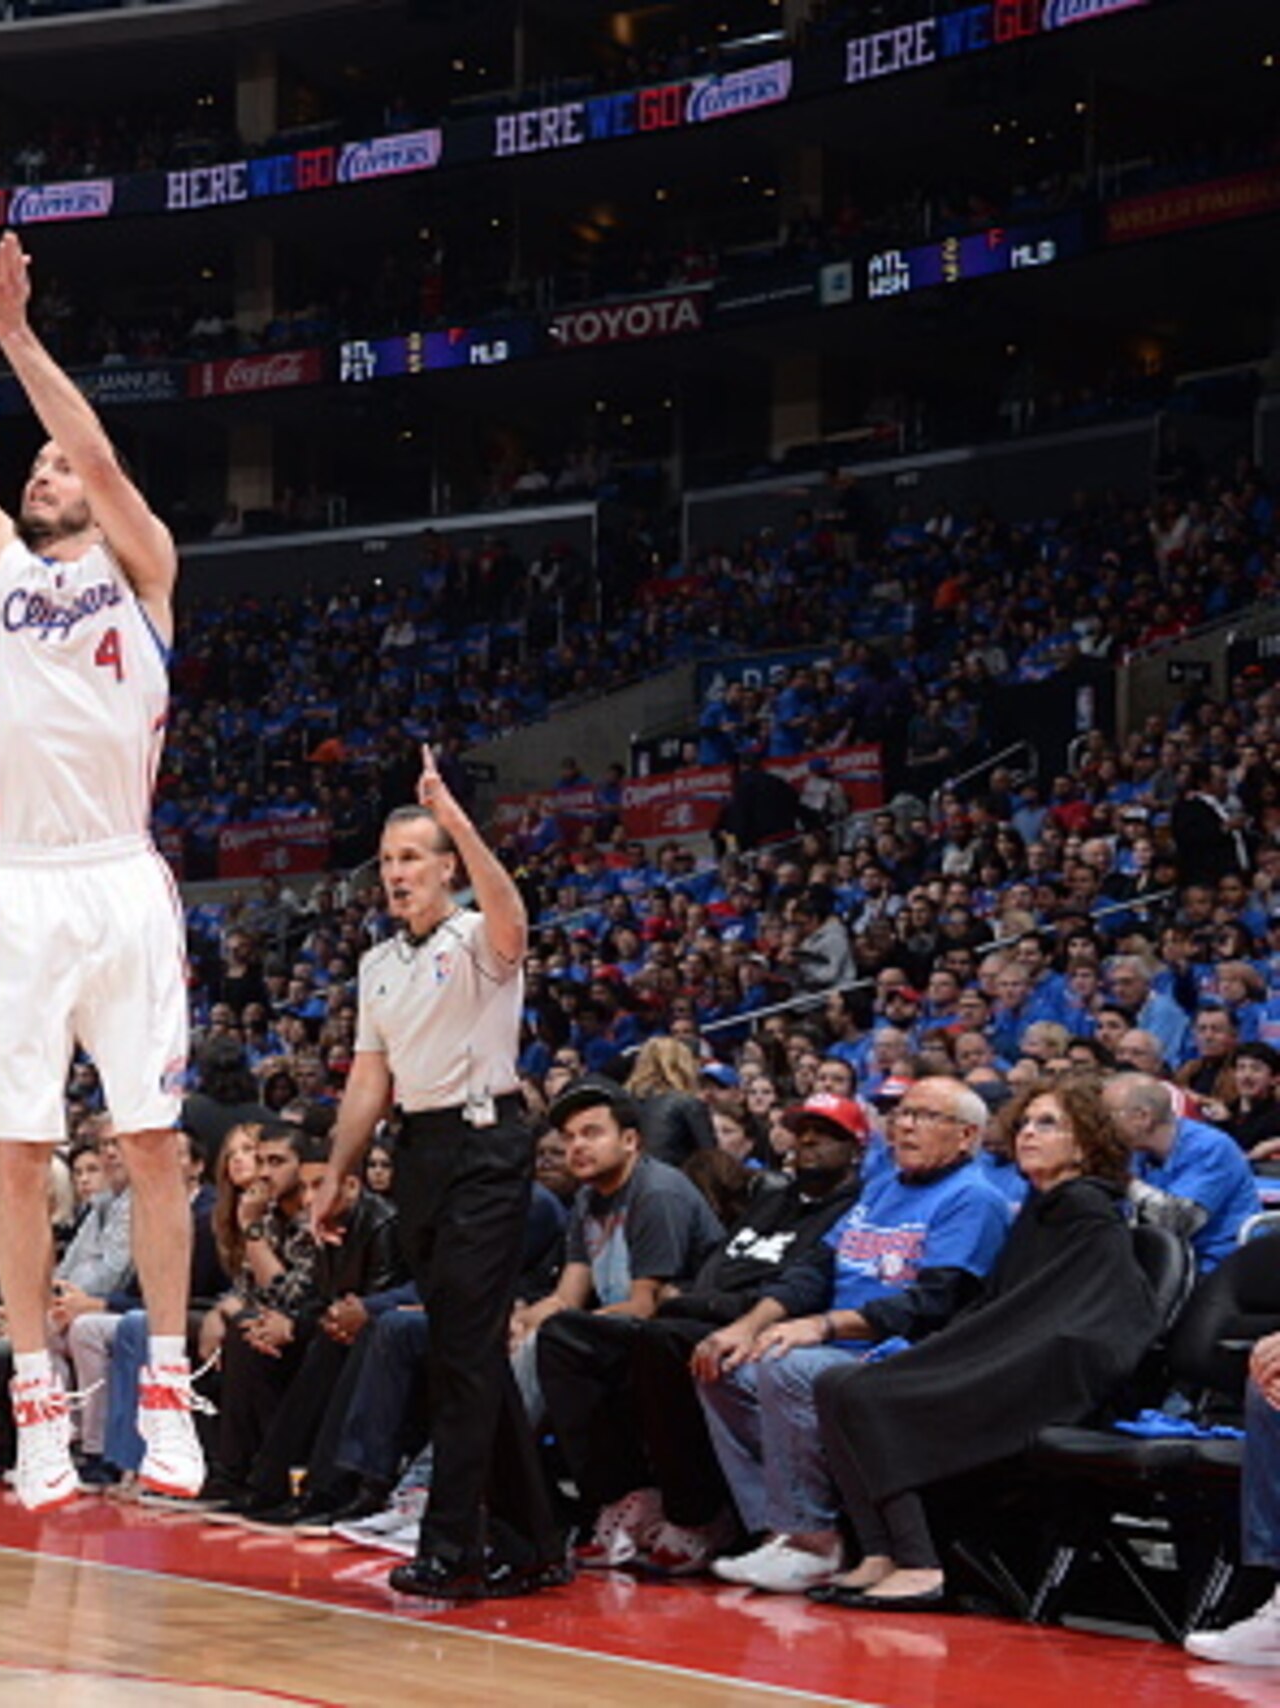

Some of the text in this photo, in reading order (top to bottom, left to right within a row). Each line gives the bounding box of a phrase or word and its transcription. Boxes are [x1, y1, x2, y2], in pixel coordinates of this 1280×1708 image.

[845, 17, 936, 84] HERE
[938, 6, 992, 58] WE
[992, 0, 1039, 45] GO
[494, 102, 585, 157] HERE
[586, 92, 637, 141] WE
[638, 86, 682, 133] GO
[166, 160, 248, 209] HERE
[248, 154, 296, 197] WE
[296, 145, 334, 191] GO
[868, 248, 910, 274] ATL
[1010, 239, 1058, 270] MLB
[867, 271, 910, 300] WSH
[551, 298, 702, 345] TOYOTA
[470, 339, 508, 366] MLB
[3, 581, 122, 640] Clippers
[94, 627, 124, 683] 4
